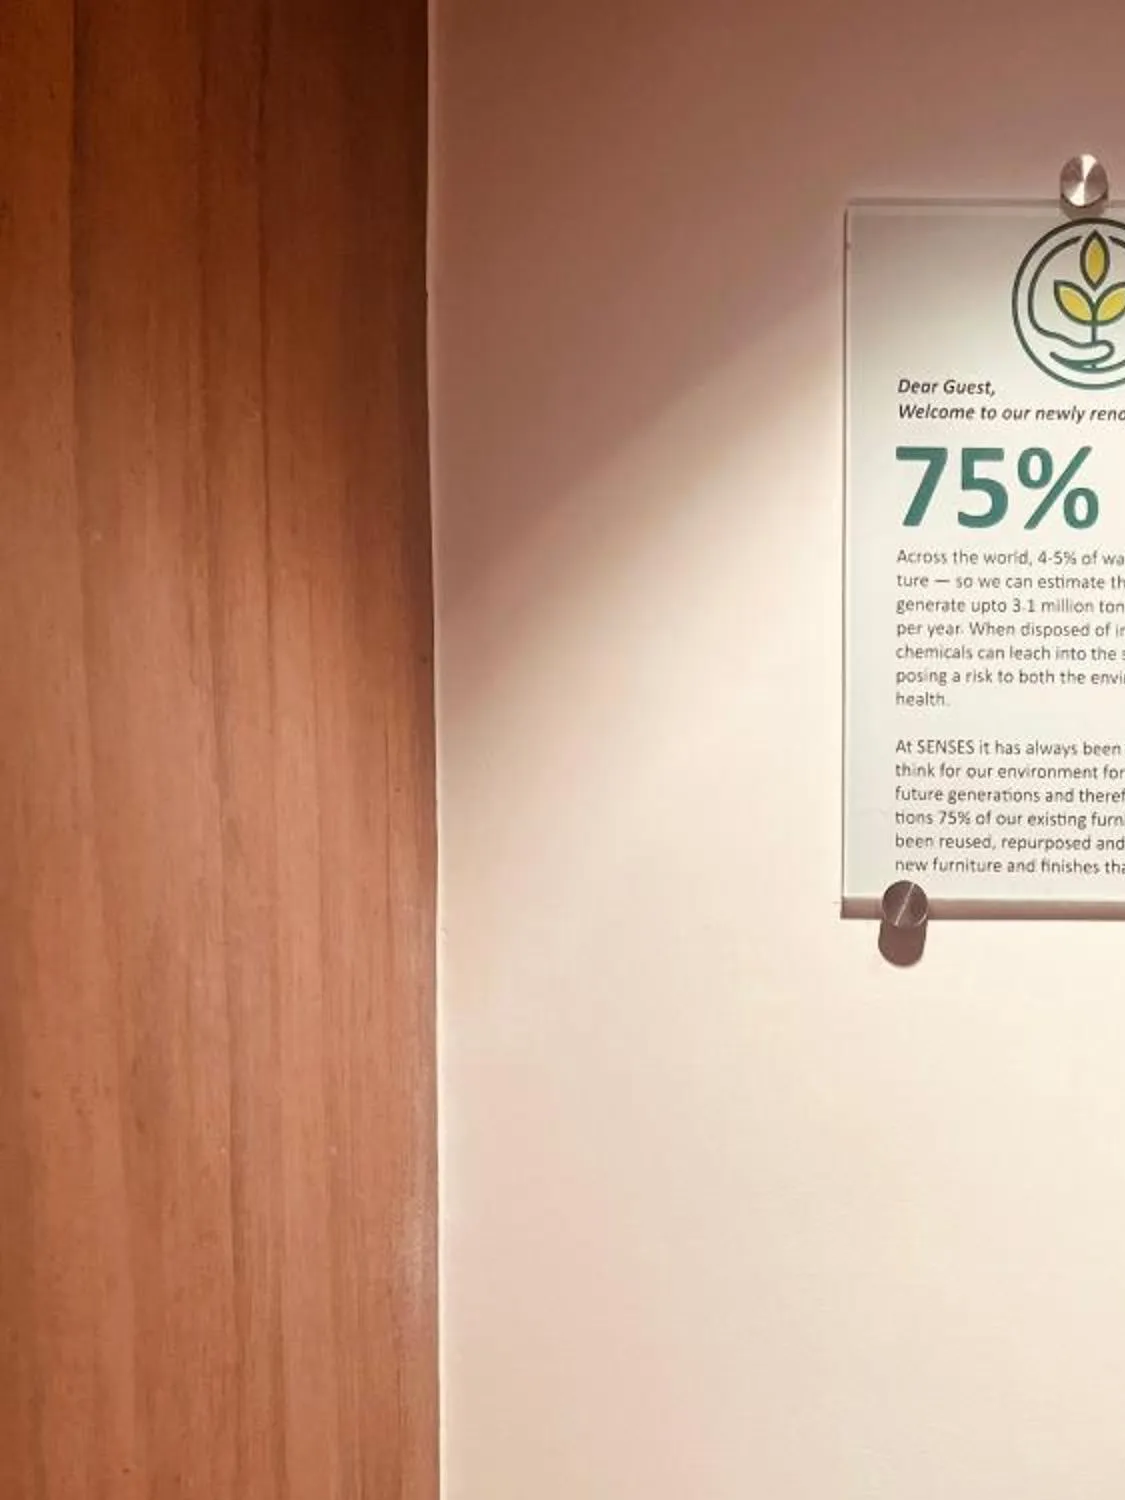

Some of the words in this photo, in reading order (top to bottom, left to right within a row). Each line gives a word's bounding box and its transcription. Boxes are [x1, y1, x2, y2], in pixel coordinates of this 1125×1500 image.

[898, 379, 939, 394] Dear
[943, 379, 995, 397] Guest,
[899, 403, 975, 420] Welcome
[981, 406, 997, 420] to
[1001, 408, 1032, 421] our
[1035, 405, 1086, 424] newly
[896, 446, 1099, 530] 75%
[896, 549, 948, 564] Across
[952, 549, 979, 565] the
[983, 549, 1032, 567] world,
[1037, 550, 1077, 565] 4-5%
[1081, 550, 1098, 566] of
[897, 574, 929, 589] ture
[956, 576, 973, 589] so
[977, 576, 1001, 589] we
[1005, 577, 1032, 589] can
[1037, 574, 1106, 590] estimate
[896, 598, 966, 615] generate
[971, 599, 1007, 615] upto
[1040, 597, 1094, 616] million
[897, 624, 923, 638] per
[969, 621, 1015, 637] When
[1020, 622, 1090, 640] disposed
[1095, 621, 1112, 637] of
[896, 643, 973, 661] chemicals
[977, 648, 1005, 660] can
[1009, 645, 1051, 661] leach
[1055, 646, 1087, 661] into
[1090, 646, 1117, 661] the
[896, 668, 947, 686] posing
[951, 671, 960, 683] a
[965, 668, 992, 683] risk
[997, 670, 1015, 684] to
[1019, 668, 1055, 685] both
[1059, 668, 1086, 684] the
[896, 691, 949, 707] health.
[896, 739, 913, 754] At
[917, 739, 975, 755] SENSES
[979, 740, 991, 755] it
[995, 740, 1021, 755] has
[1025, 740, 1078, 759] always
[1083, 741, 1121, 756] been
[896, 762, 936, 778] think
[939, 761, 962, 779] for
[966, 767, 994, 780] our
[997, 766, 1098, 780] environment
[1103, 764, 1125, 781] for
[896, 785, 945, 802] future
[947, 787, 1041, 805] generations
[1045, 788, 1074, 803] and
[895, 809, 934, 825] tions
[938, 810, 971, 826] 75%
[975, 810, 992, 825] of
[995, 812, 1023, 826] our
[1027, 811, 1087, 831] existing
[896, 833, 934, 848] been
[939, 832, 996, 851] reused,
[1001, 834, 1092, 853] repurposed
[1096, 836, 1125, 851] and
[896, 860, 928, 872] new
[933, 856, 1003, 873] furniture
[1007, 858, 1037, 873] and
[1041, 856, 1100, 875] finishes
